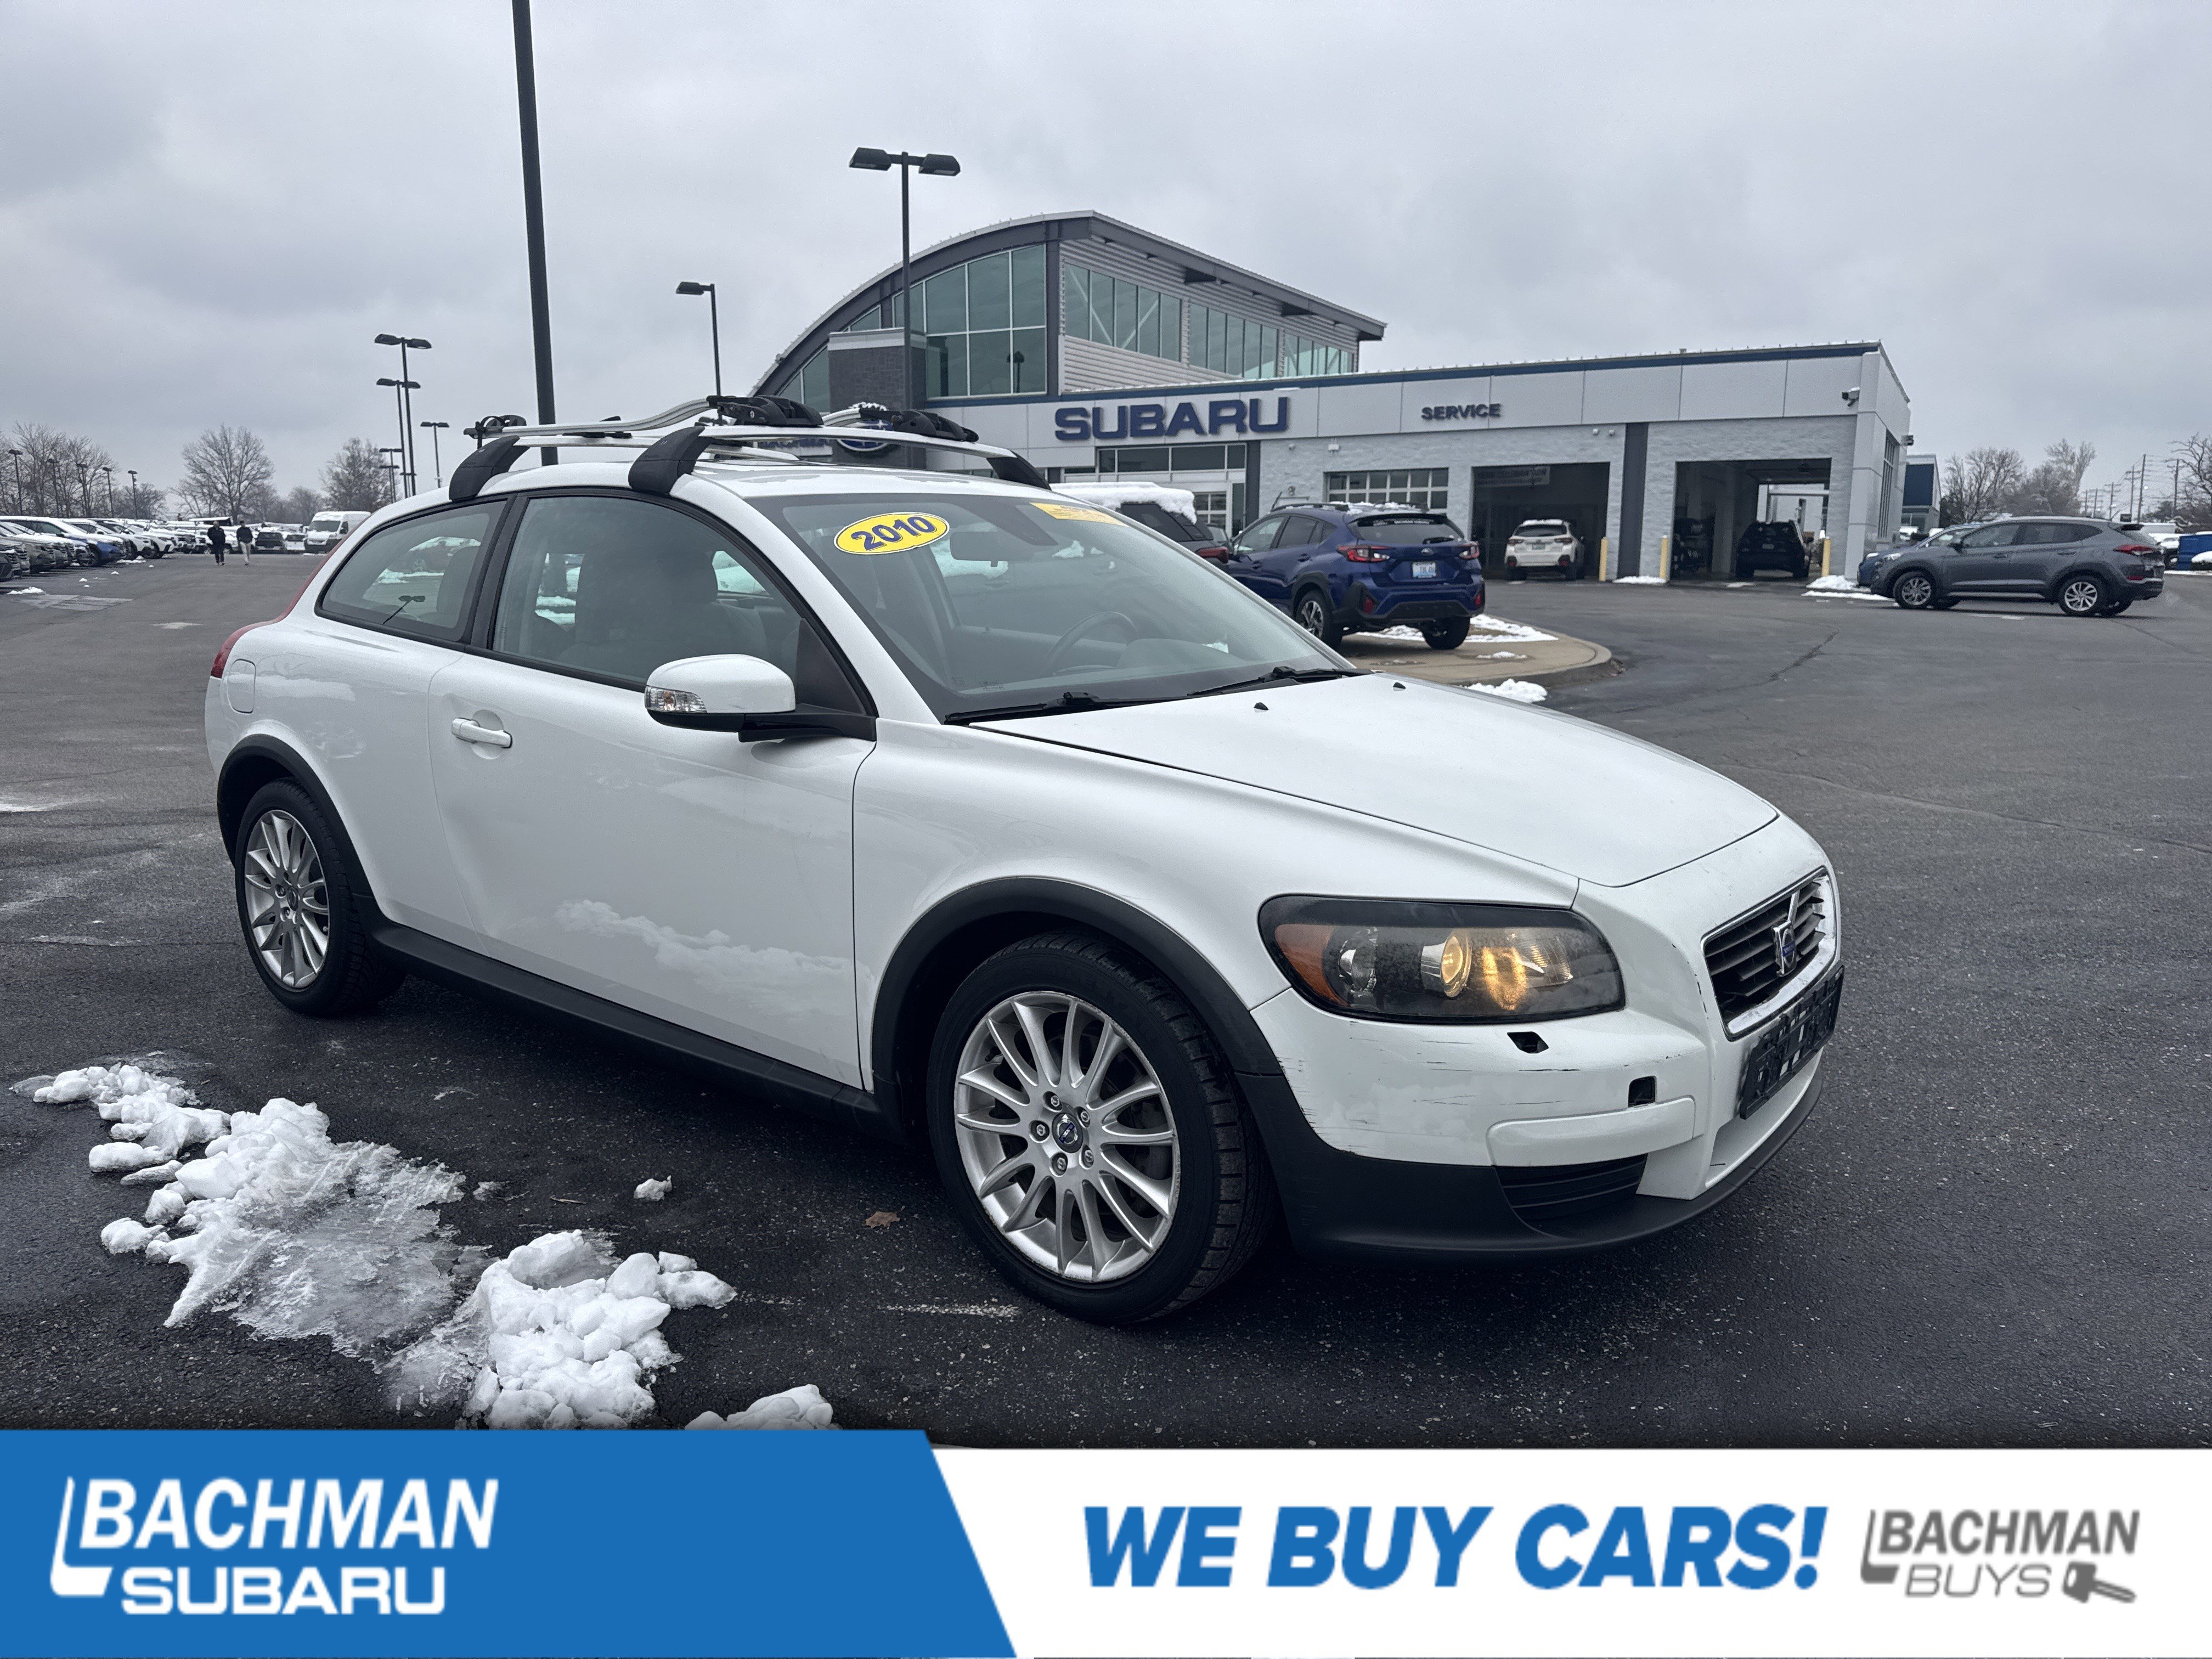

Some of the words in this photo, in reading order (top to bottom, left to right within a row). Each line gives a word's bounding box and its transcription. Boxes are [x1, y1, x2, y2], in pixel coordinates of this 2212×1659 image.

[1054, 396, 1288, 441] SUBARU
[1421, 403, 1502, 421] SERVICE
[850, 516, 936, 551] 2010
